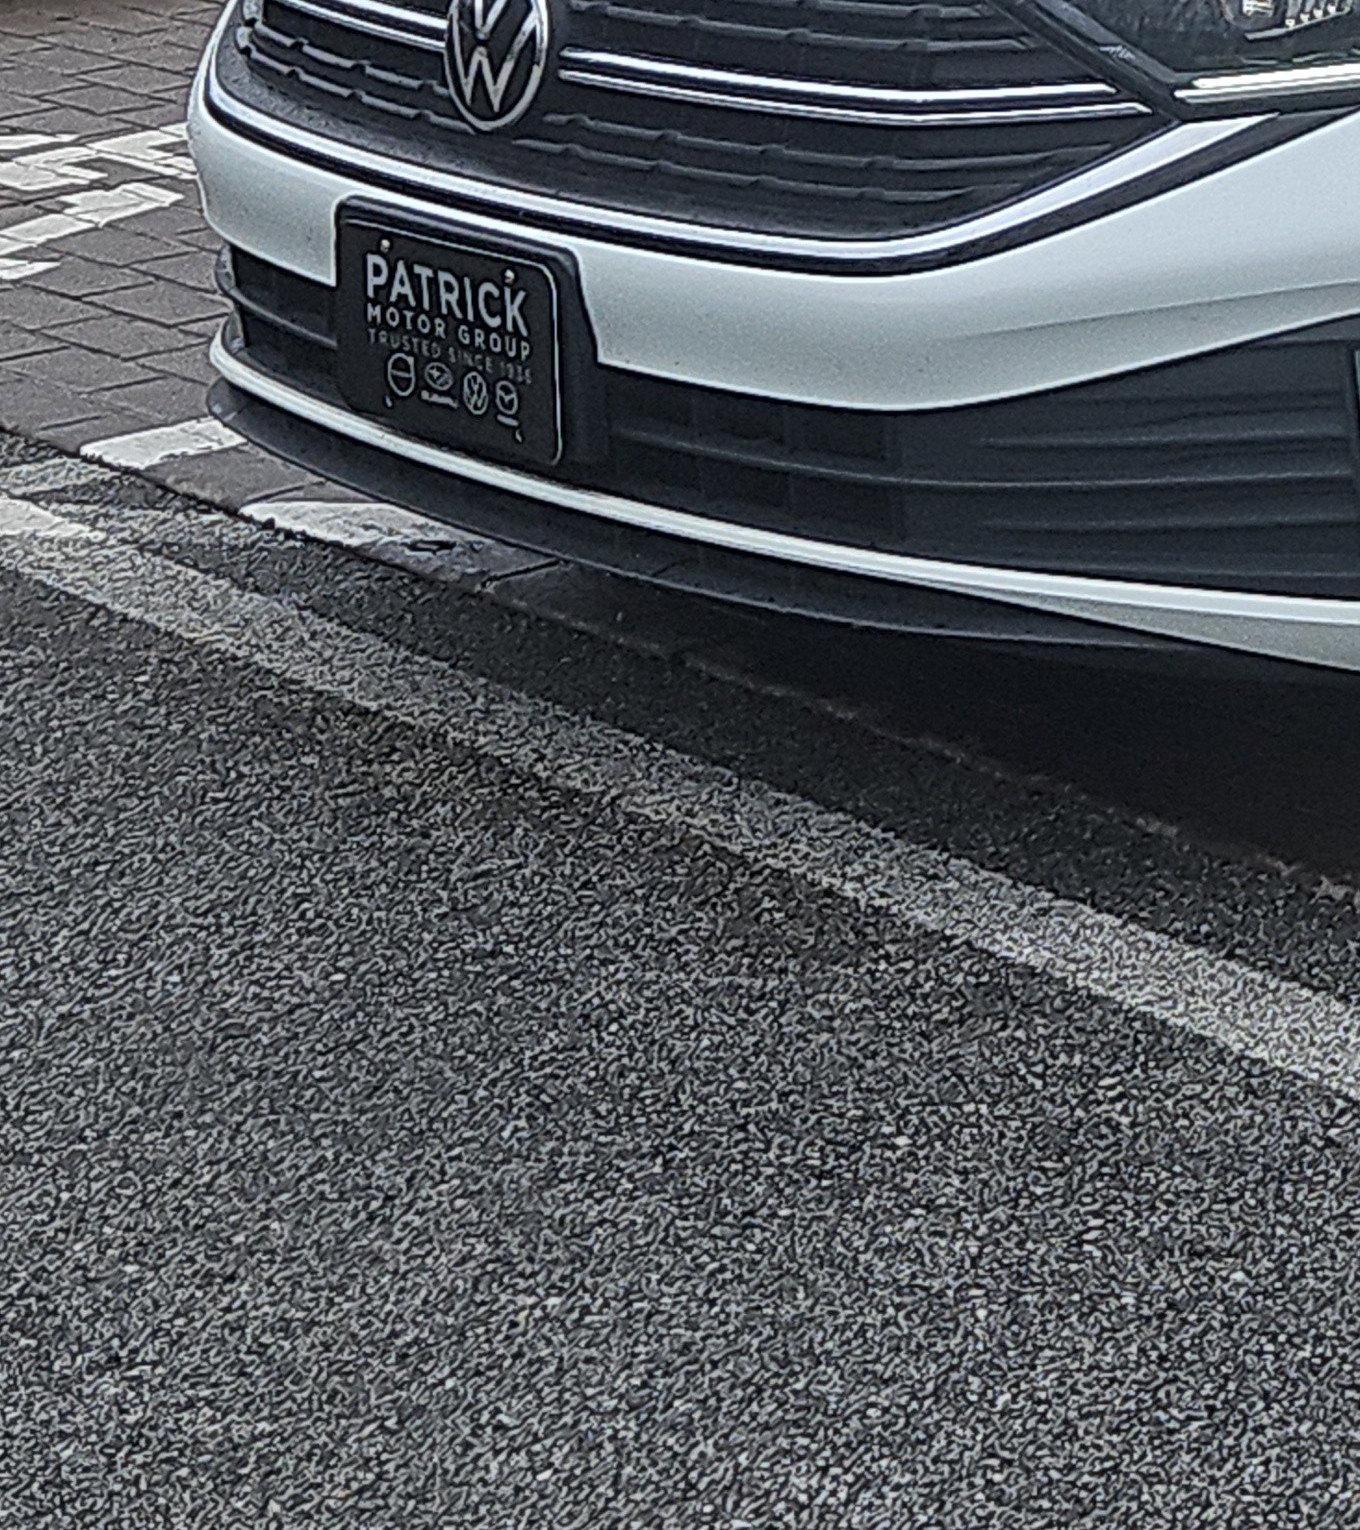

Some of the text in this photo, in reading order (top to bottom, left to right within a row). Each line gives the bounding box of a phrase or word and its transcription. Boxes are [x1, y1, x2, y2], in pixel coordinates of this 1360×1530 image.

[366, 253, 528, 338] PATRICK
[367, 302, 531, 362] MOTOR GROUP
[367, 328, 441, 359] TRUSTED
